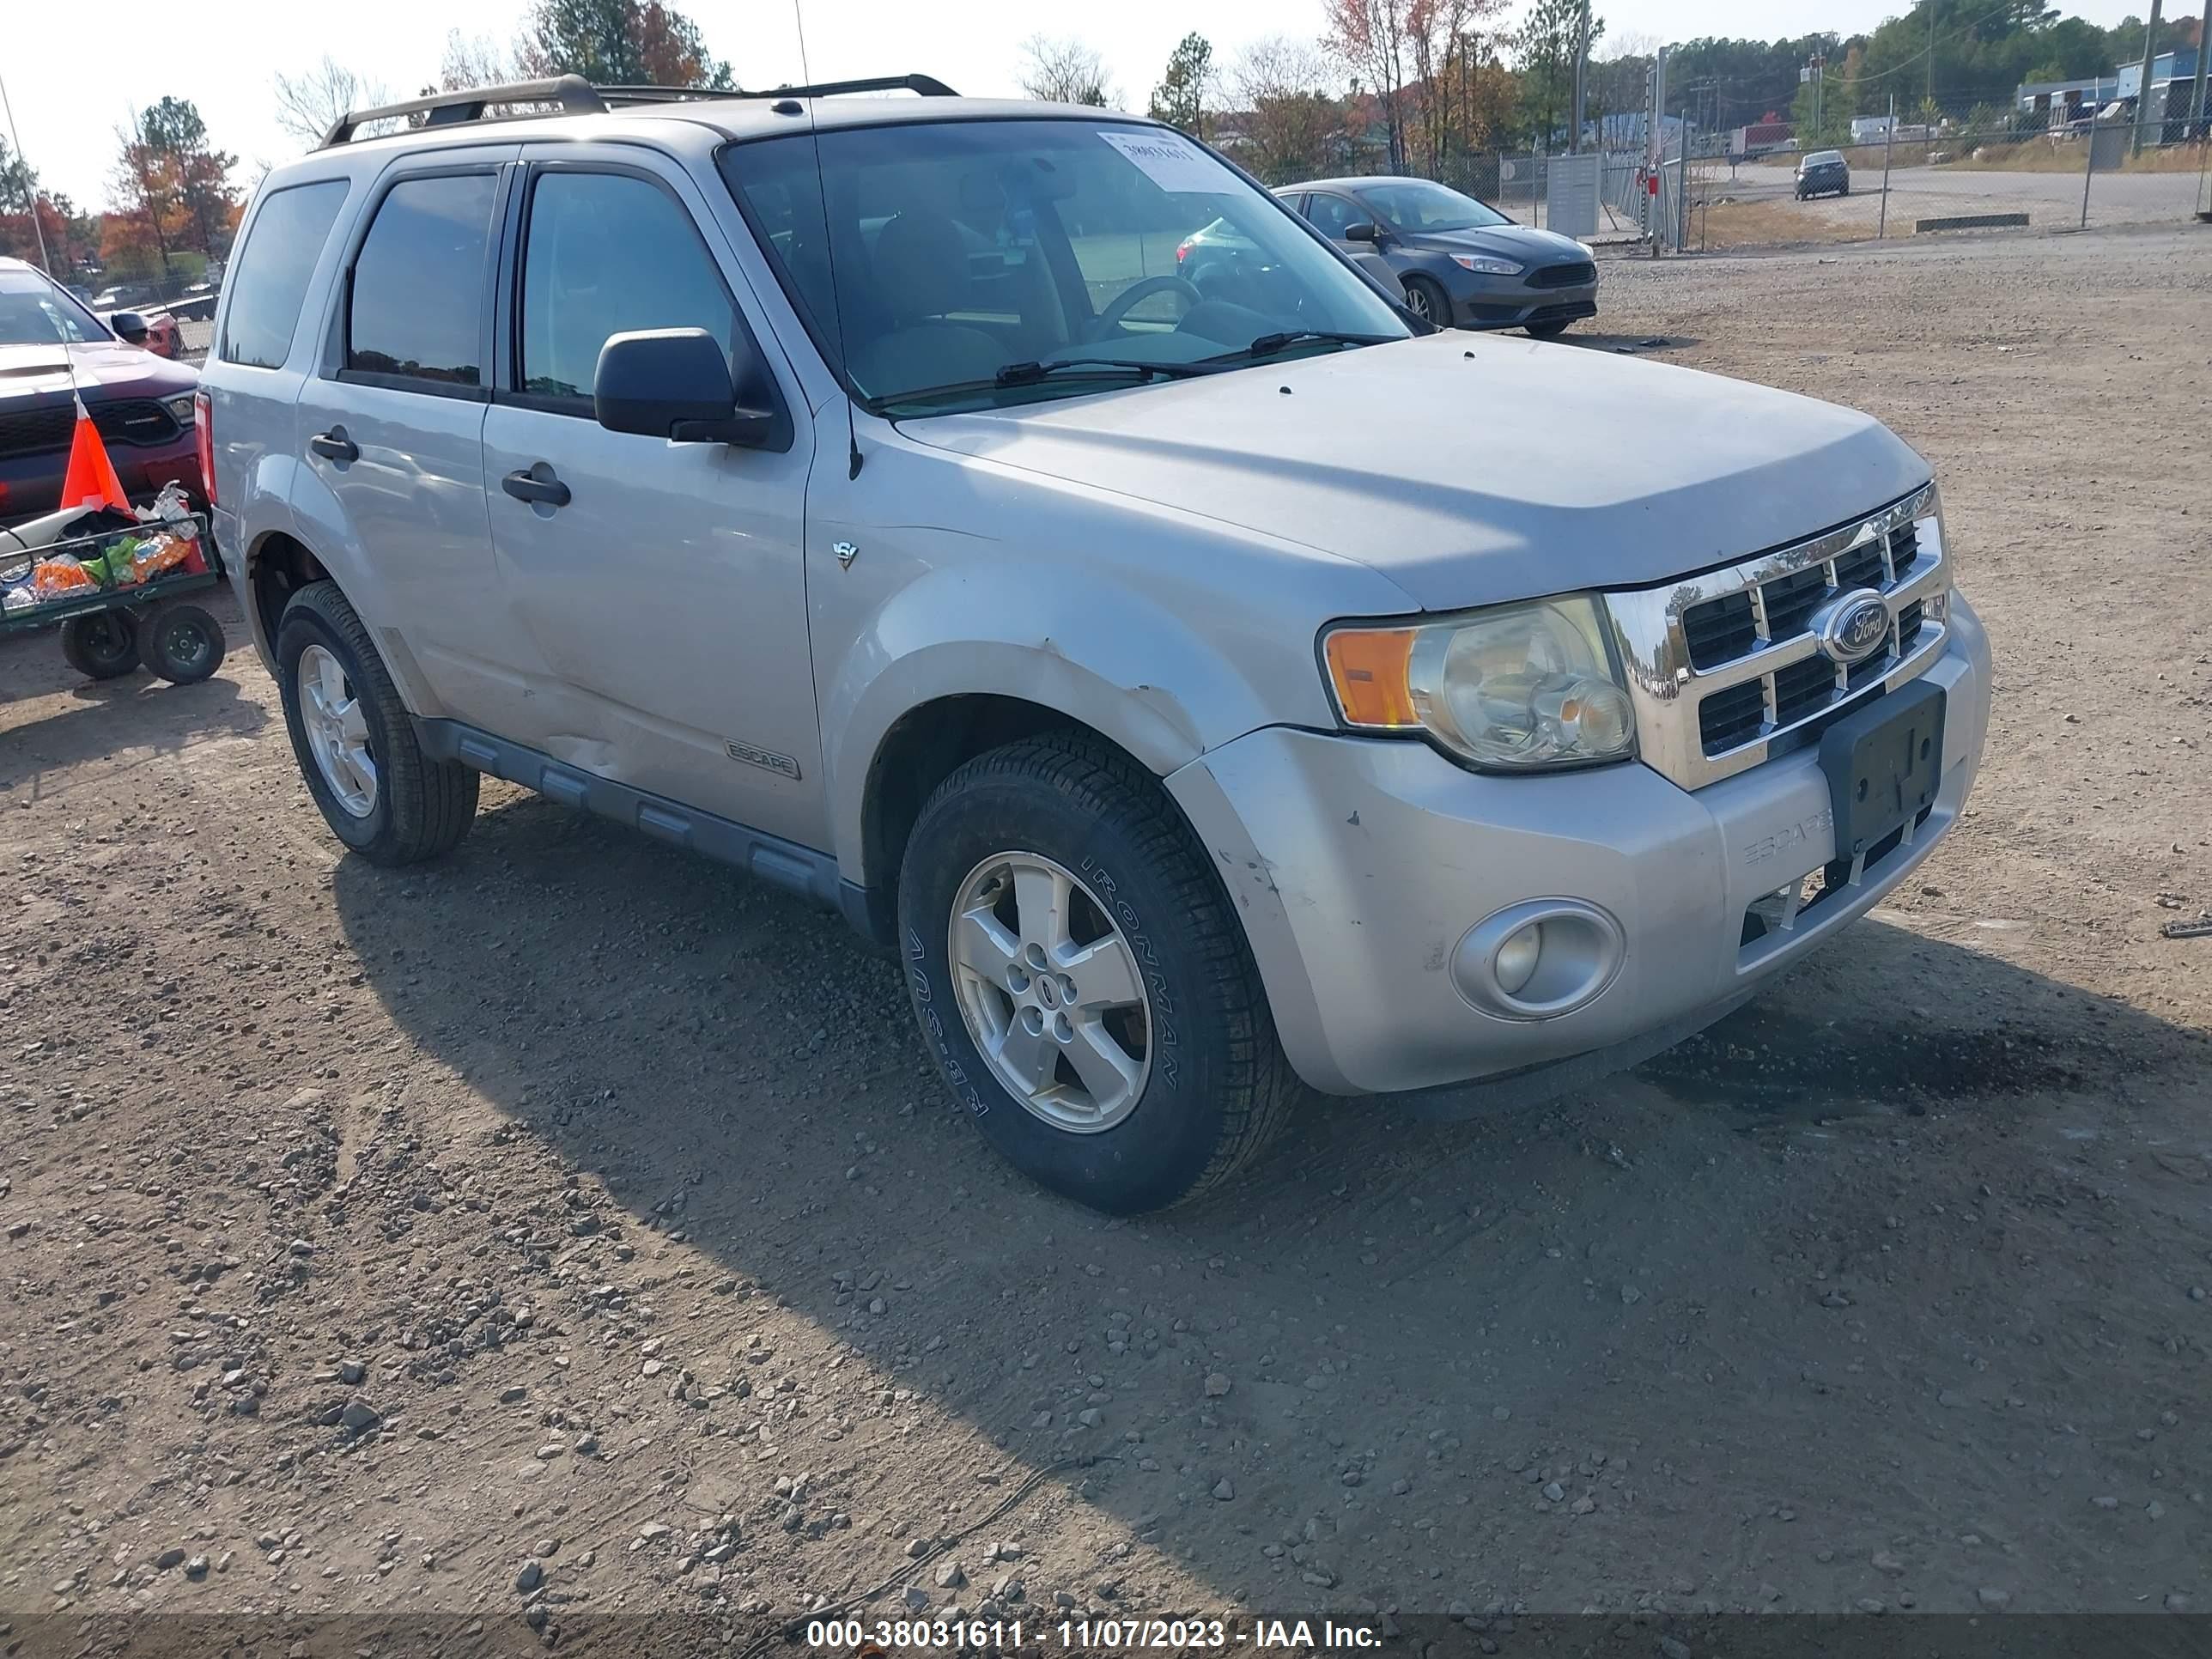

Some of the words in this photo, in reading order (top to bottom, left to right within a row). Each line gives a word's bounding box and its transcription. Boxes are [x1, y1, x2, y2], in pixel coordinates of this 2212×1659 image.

[1122, 143, 1194, 161] 38031611
[1854, 608, 1883, 643] Ford
[728, 742, 794, 775] ESCAPE
[1743, 808, 1834, 866] ESCAPE
[1080, 854, 1177, 1091] IRONMAN
